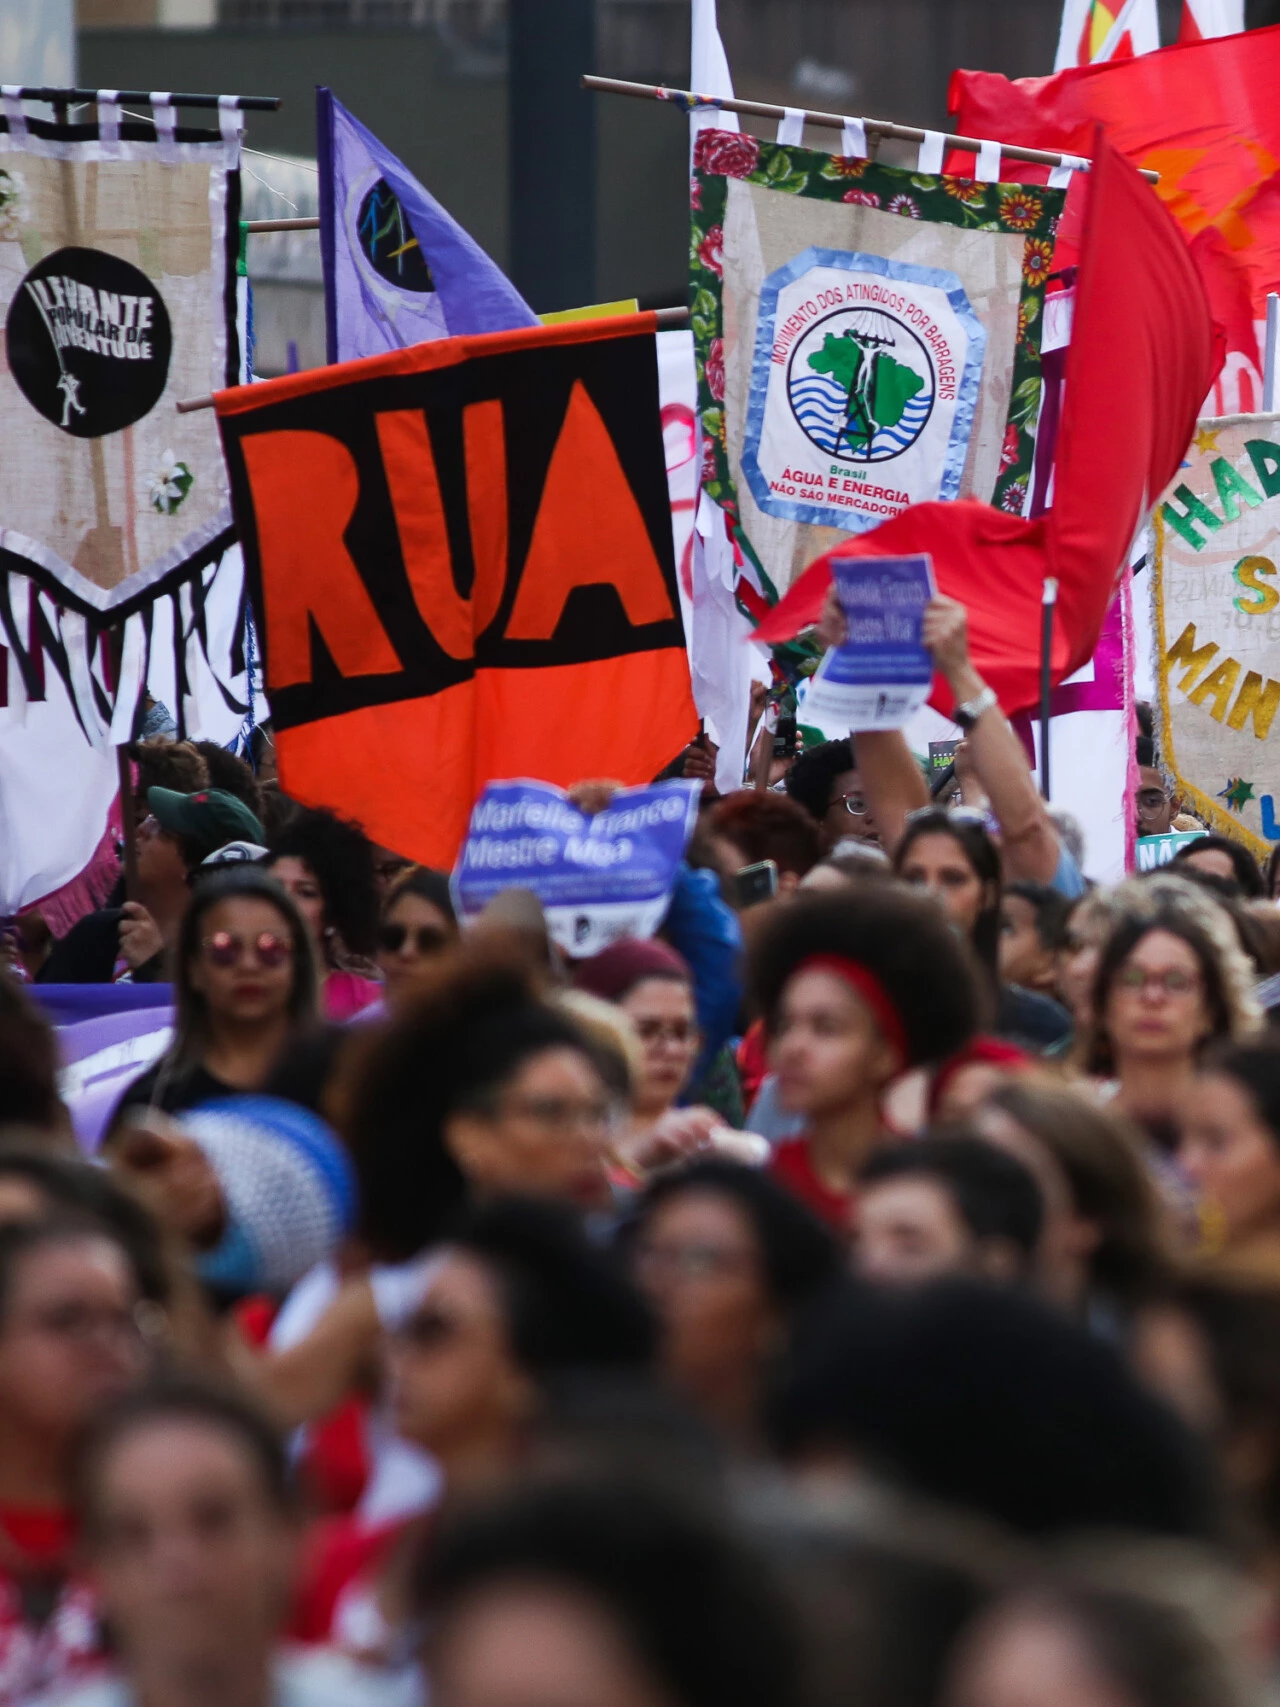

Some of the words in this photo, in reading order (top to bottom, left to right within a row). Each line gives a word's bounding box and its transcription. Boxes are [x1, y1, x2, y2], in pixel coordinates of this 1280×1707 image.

[32, 275, 153, 328] LEVANTE
[49, 306, 120, 342] POPULAR
[771, 300, 819, 367] MOVIMENTO
[816, 287, 844, 311] DOS
[846, 284, 906, 313] ATINGIDOS
[904, 302, 930, 331] POR
[924, 325, 955, 401] BARRAGENS
[769, 480, 796, 496] NÃO
[799, 486, 824, 502] SÃO
[781, 464, 830, 489] ÁGUA
[828, 477, 838, 489] E
[842, 481, 911, 504] ENERGIA
[829, 464, 867, 480] Brasil
[239, 378, 675, 691] RUA
